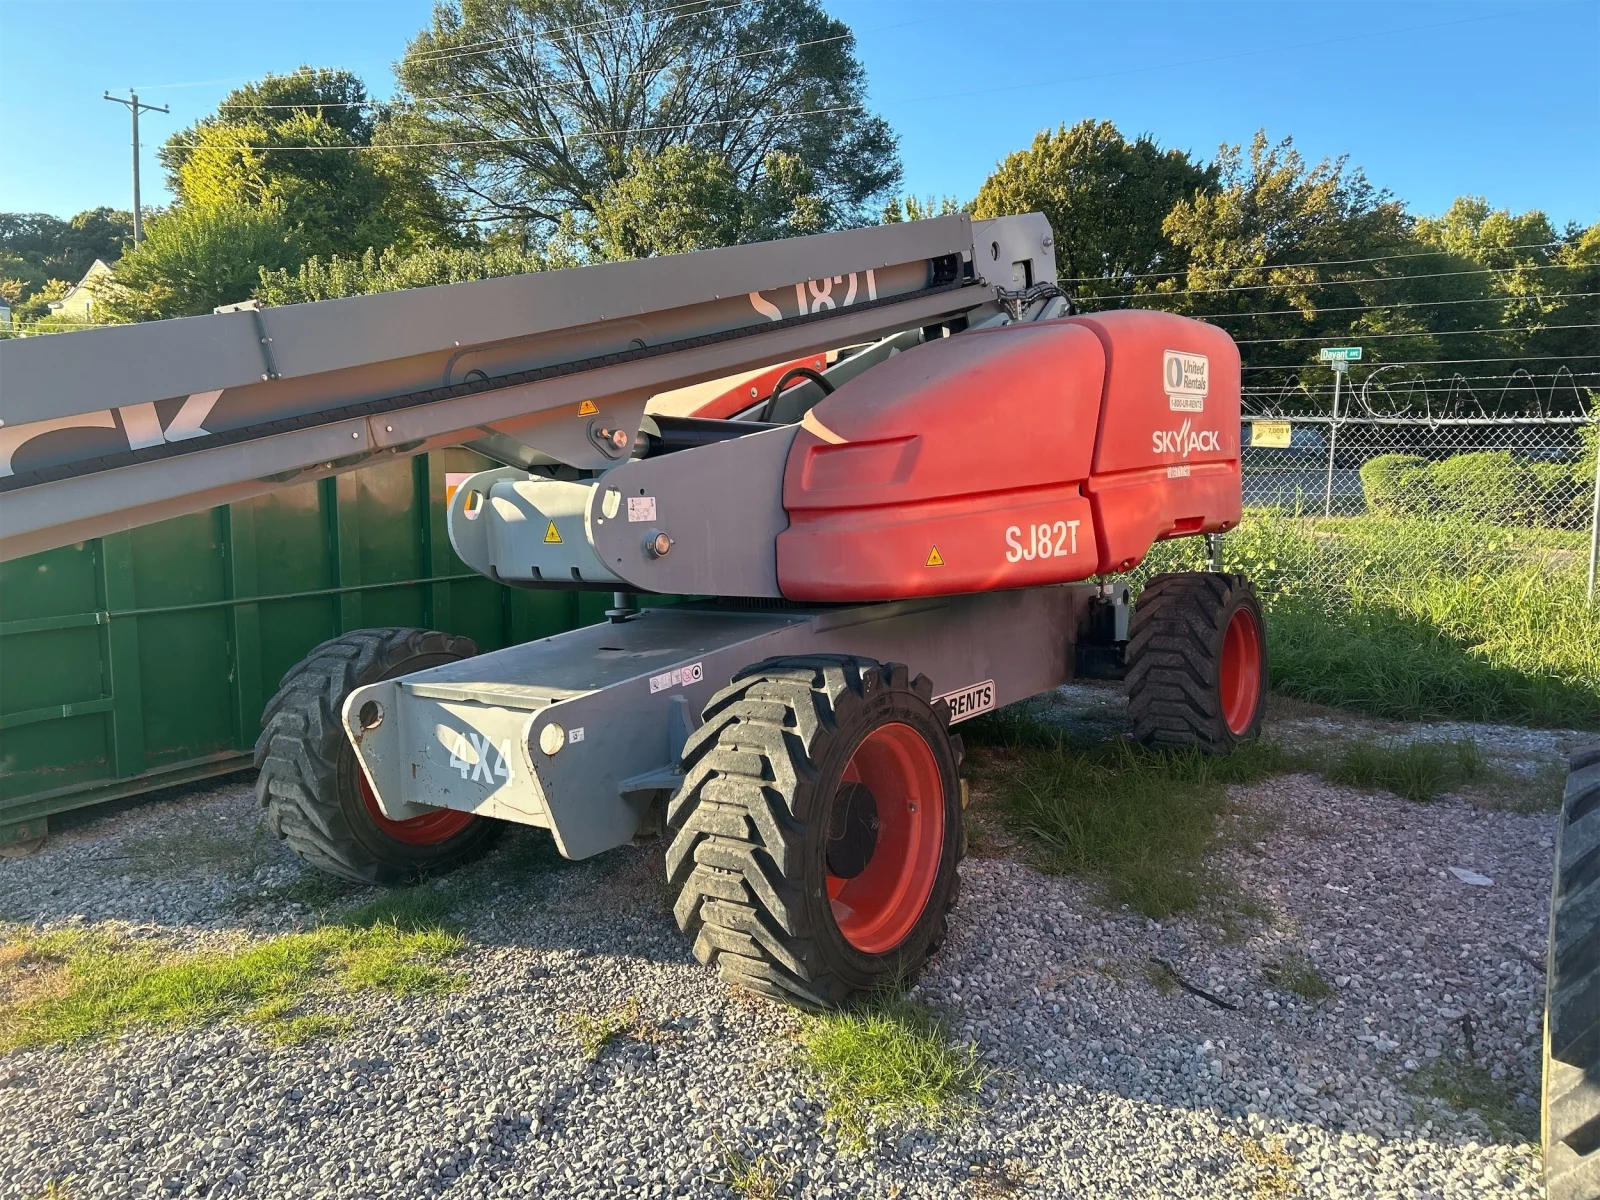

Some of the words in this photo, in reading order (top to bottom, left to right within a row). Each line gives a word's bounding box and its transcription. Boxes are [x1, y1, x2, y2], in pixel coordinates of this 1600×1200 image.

[1184, 360, 1205, 375] United
[1184, 375, 1206, 390] Rentals
[1152, 417, 1221, 458] SKYJACK
[1005, 519, 1081, 563] SJ82T
[449, 732, 516, 788] 4X4
